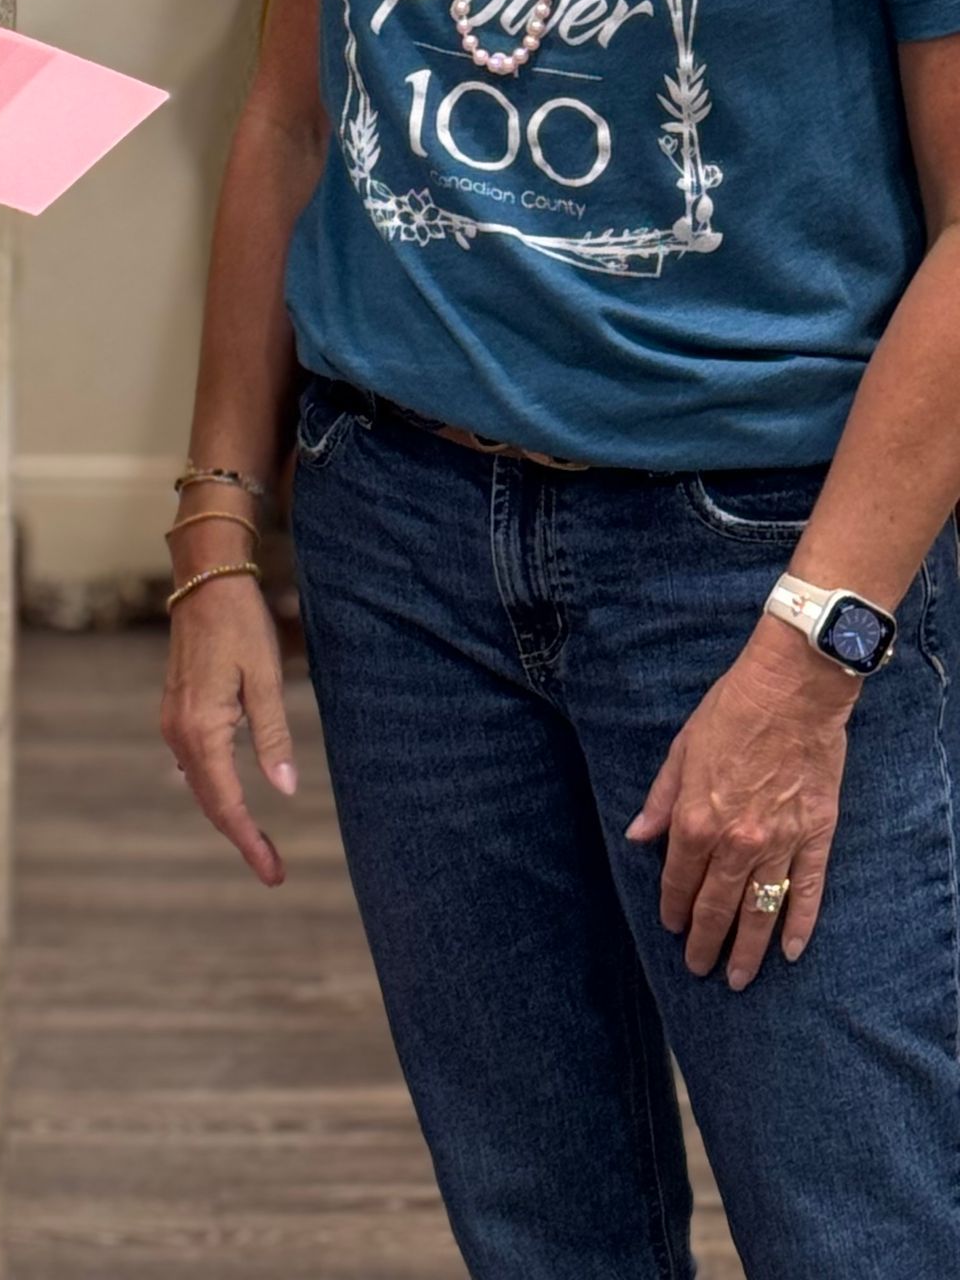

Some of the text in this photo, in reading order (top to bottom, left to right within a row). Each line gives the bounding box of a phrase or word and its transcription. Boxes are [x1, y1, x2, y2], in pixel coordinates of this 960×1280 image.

[404, 69, 612, 188] 100
[430, 170, 587, 221] Canadian County
